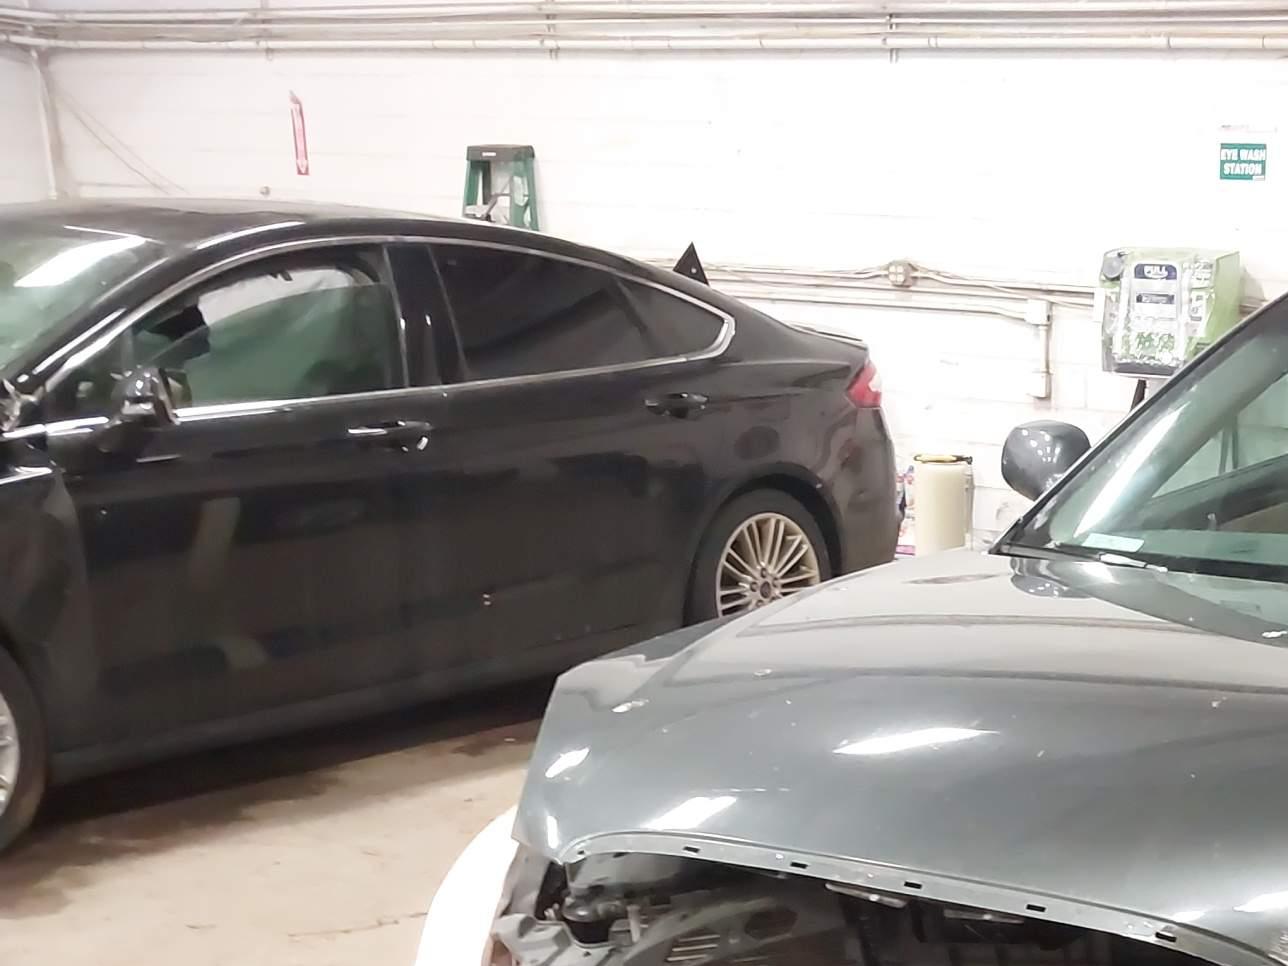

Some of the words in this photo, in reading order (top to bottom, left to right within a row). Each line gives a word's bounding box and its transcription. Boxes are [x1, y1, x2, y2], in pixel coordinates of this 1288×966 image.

[1220, 148, 1239, 160] EYE
[1240, 148, 1266, 161] WASH
[1223, 162, 1262, 176] STATION
